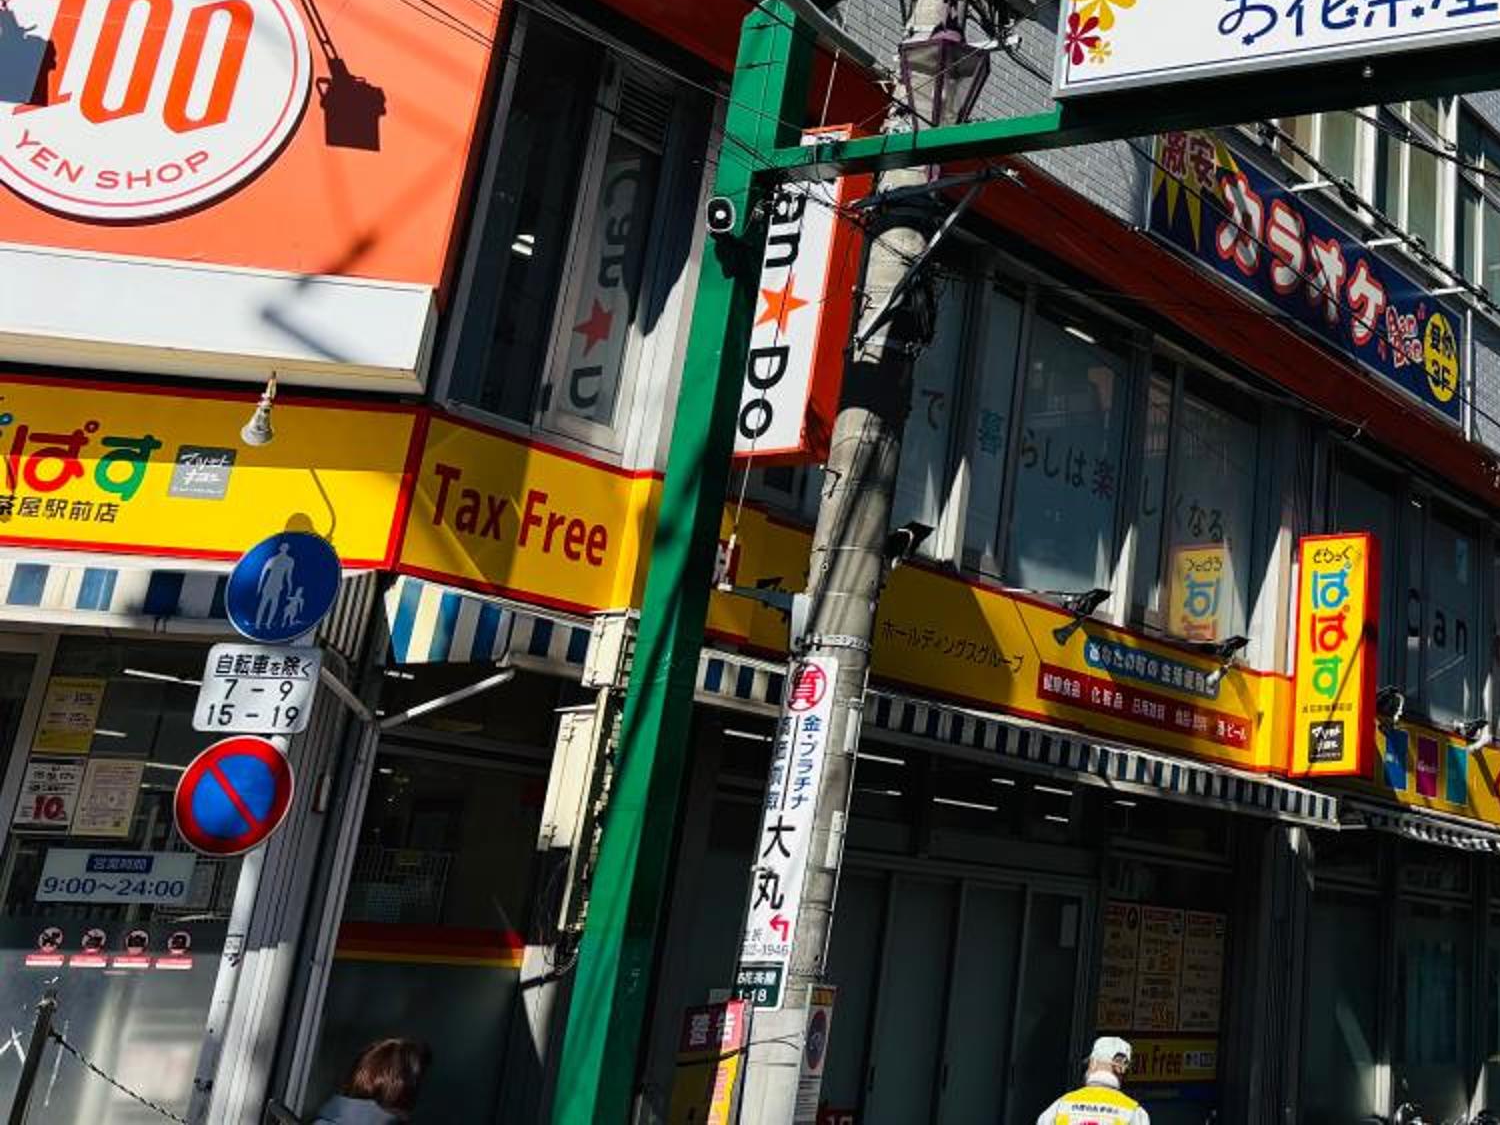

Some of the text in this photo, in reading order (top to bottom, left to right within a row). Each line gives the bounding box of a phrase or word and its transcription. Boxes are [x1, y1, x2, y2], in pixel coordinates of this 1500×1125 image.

[15, 128, 211, 190] YEN SHOP
[431, 463, 609, 566] Tax Free
[215, 653, 313, 678] 自転車を除く
[880, 621, 1026, 673] ホールディングスグループ
[753, 813, 796, 912] 大丸
